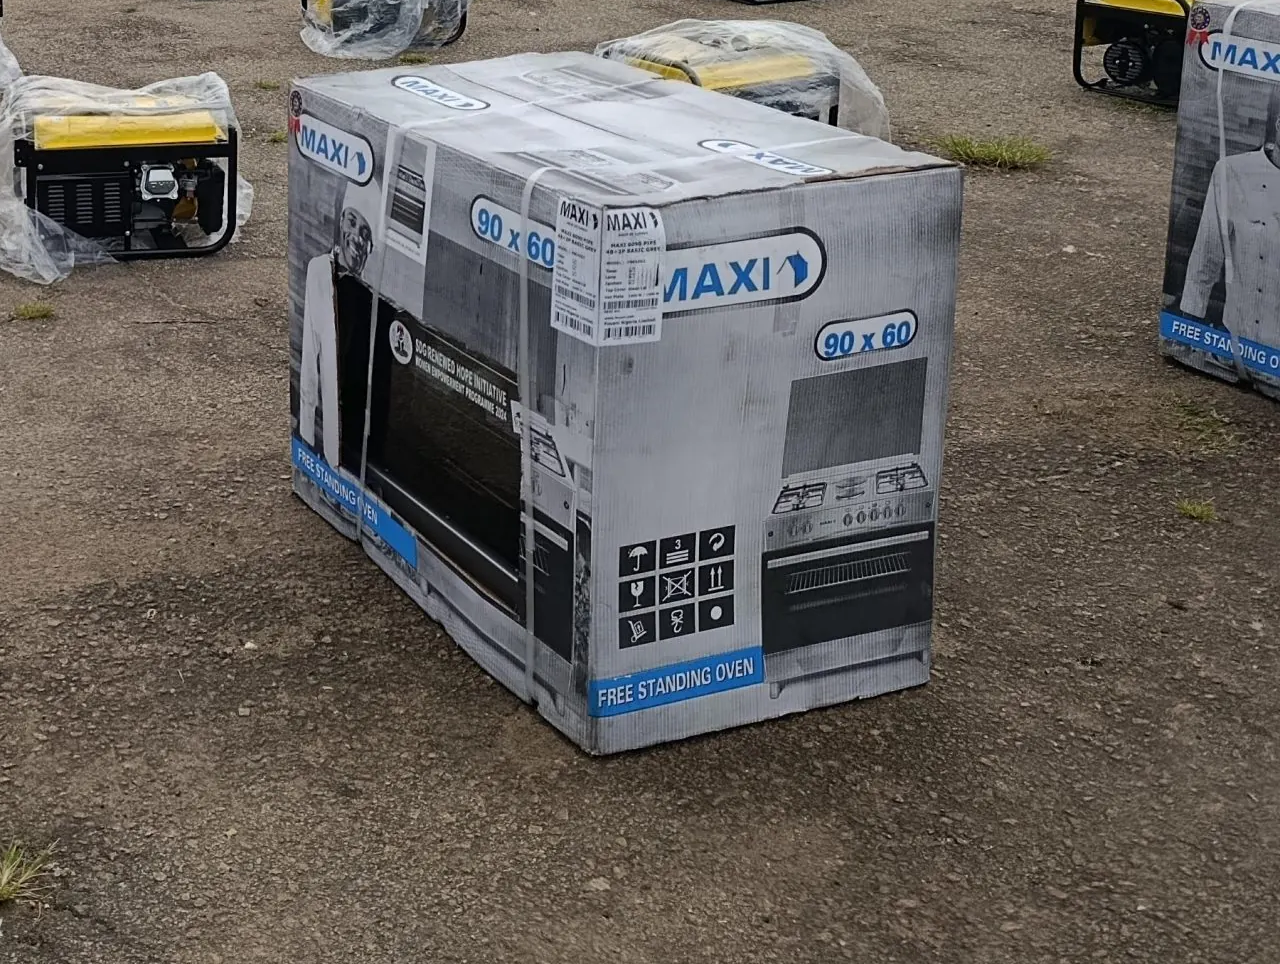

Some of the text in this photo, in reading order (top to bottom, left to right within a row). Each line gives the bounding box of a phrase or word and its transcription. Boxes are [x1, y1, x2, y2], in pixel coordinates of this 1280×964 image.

[1210, 41, 1280, 74] MAX
[401, 79, 456, 104] MAXI
[300, 124, 348, 169] MAXI
[751, 152, 819, 174] MAX
[560, 200, 589, 227] MAXI
[607, 211, 648, 231] MAXI
[477, 208, 555, 267] 90 x 60
[824, 320, 911, 357] 90 x 60
[1171, 320, 1201, 341] FREE
[456, 363, 473, 386] HOPE
[473, 372, 507, 406] INITIATIVE
[465, 387, 495, 414] PROGRAMME
[298, 447, 377, 525] FREE STANDING VEN
[674, 539, 682, 550] 3
[598, 656, 754, 708] FREE STANDING OVEN
